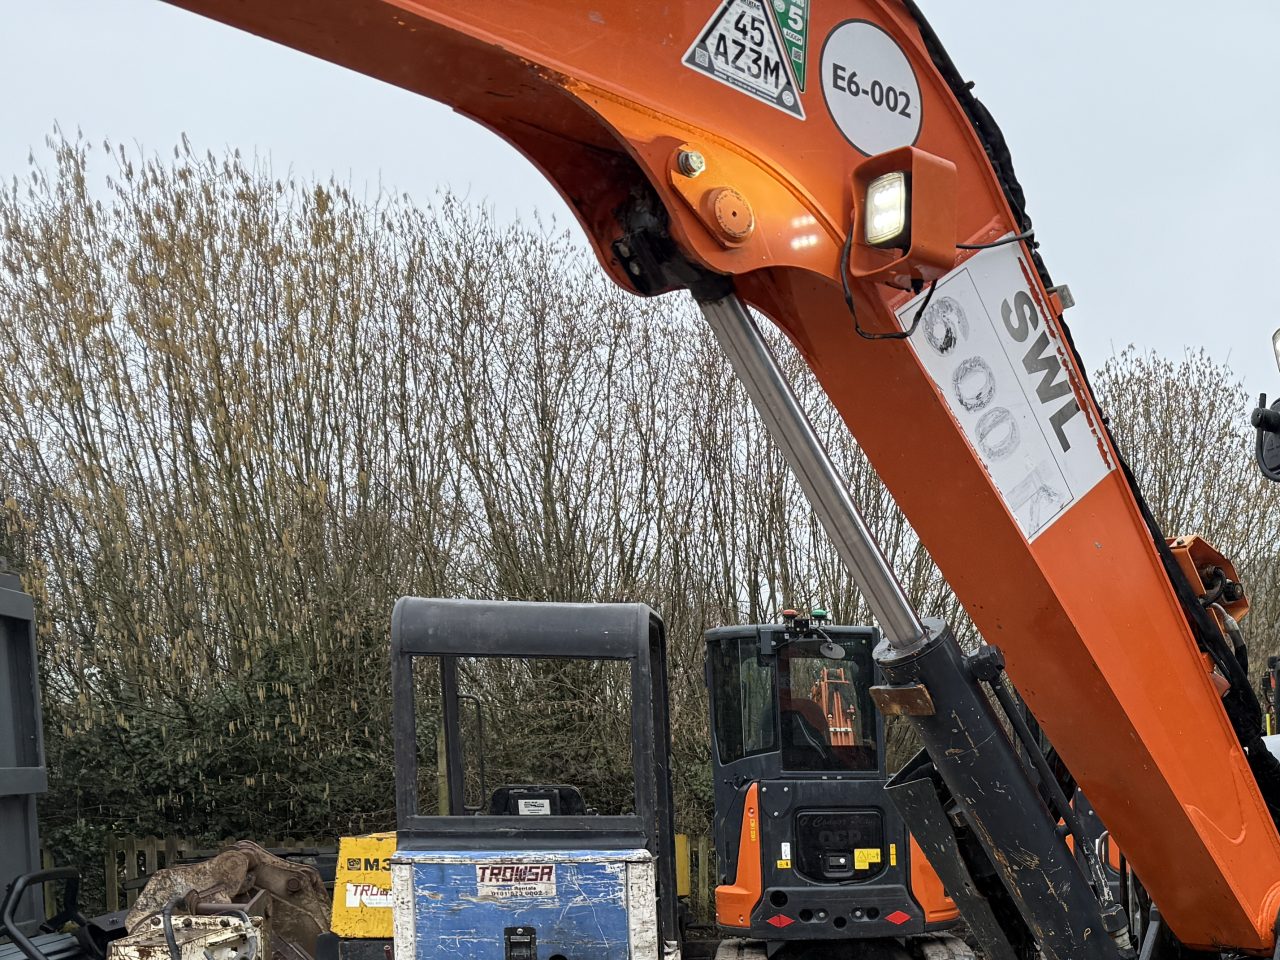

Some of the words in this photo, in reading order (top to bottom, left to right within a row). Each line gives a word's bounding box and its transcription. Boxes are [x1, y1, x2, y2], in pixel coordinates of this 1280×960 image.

[734, 10, 764, 48] 45
[714, 33, 780, 90] AZ3M
[832, 63, 912, 118] E6-002
[1000, 290, 1081, 453] SWL
[479, 866, 553, 883] TROWSA
